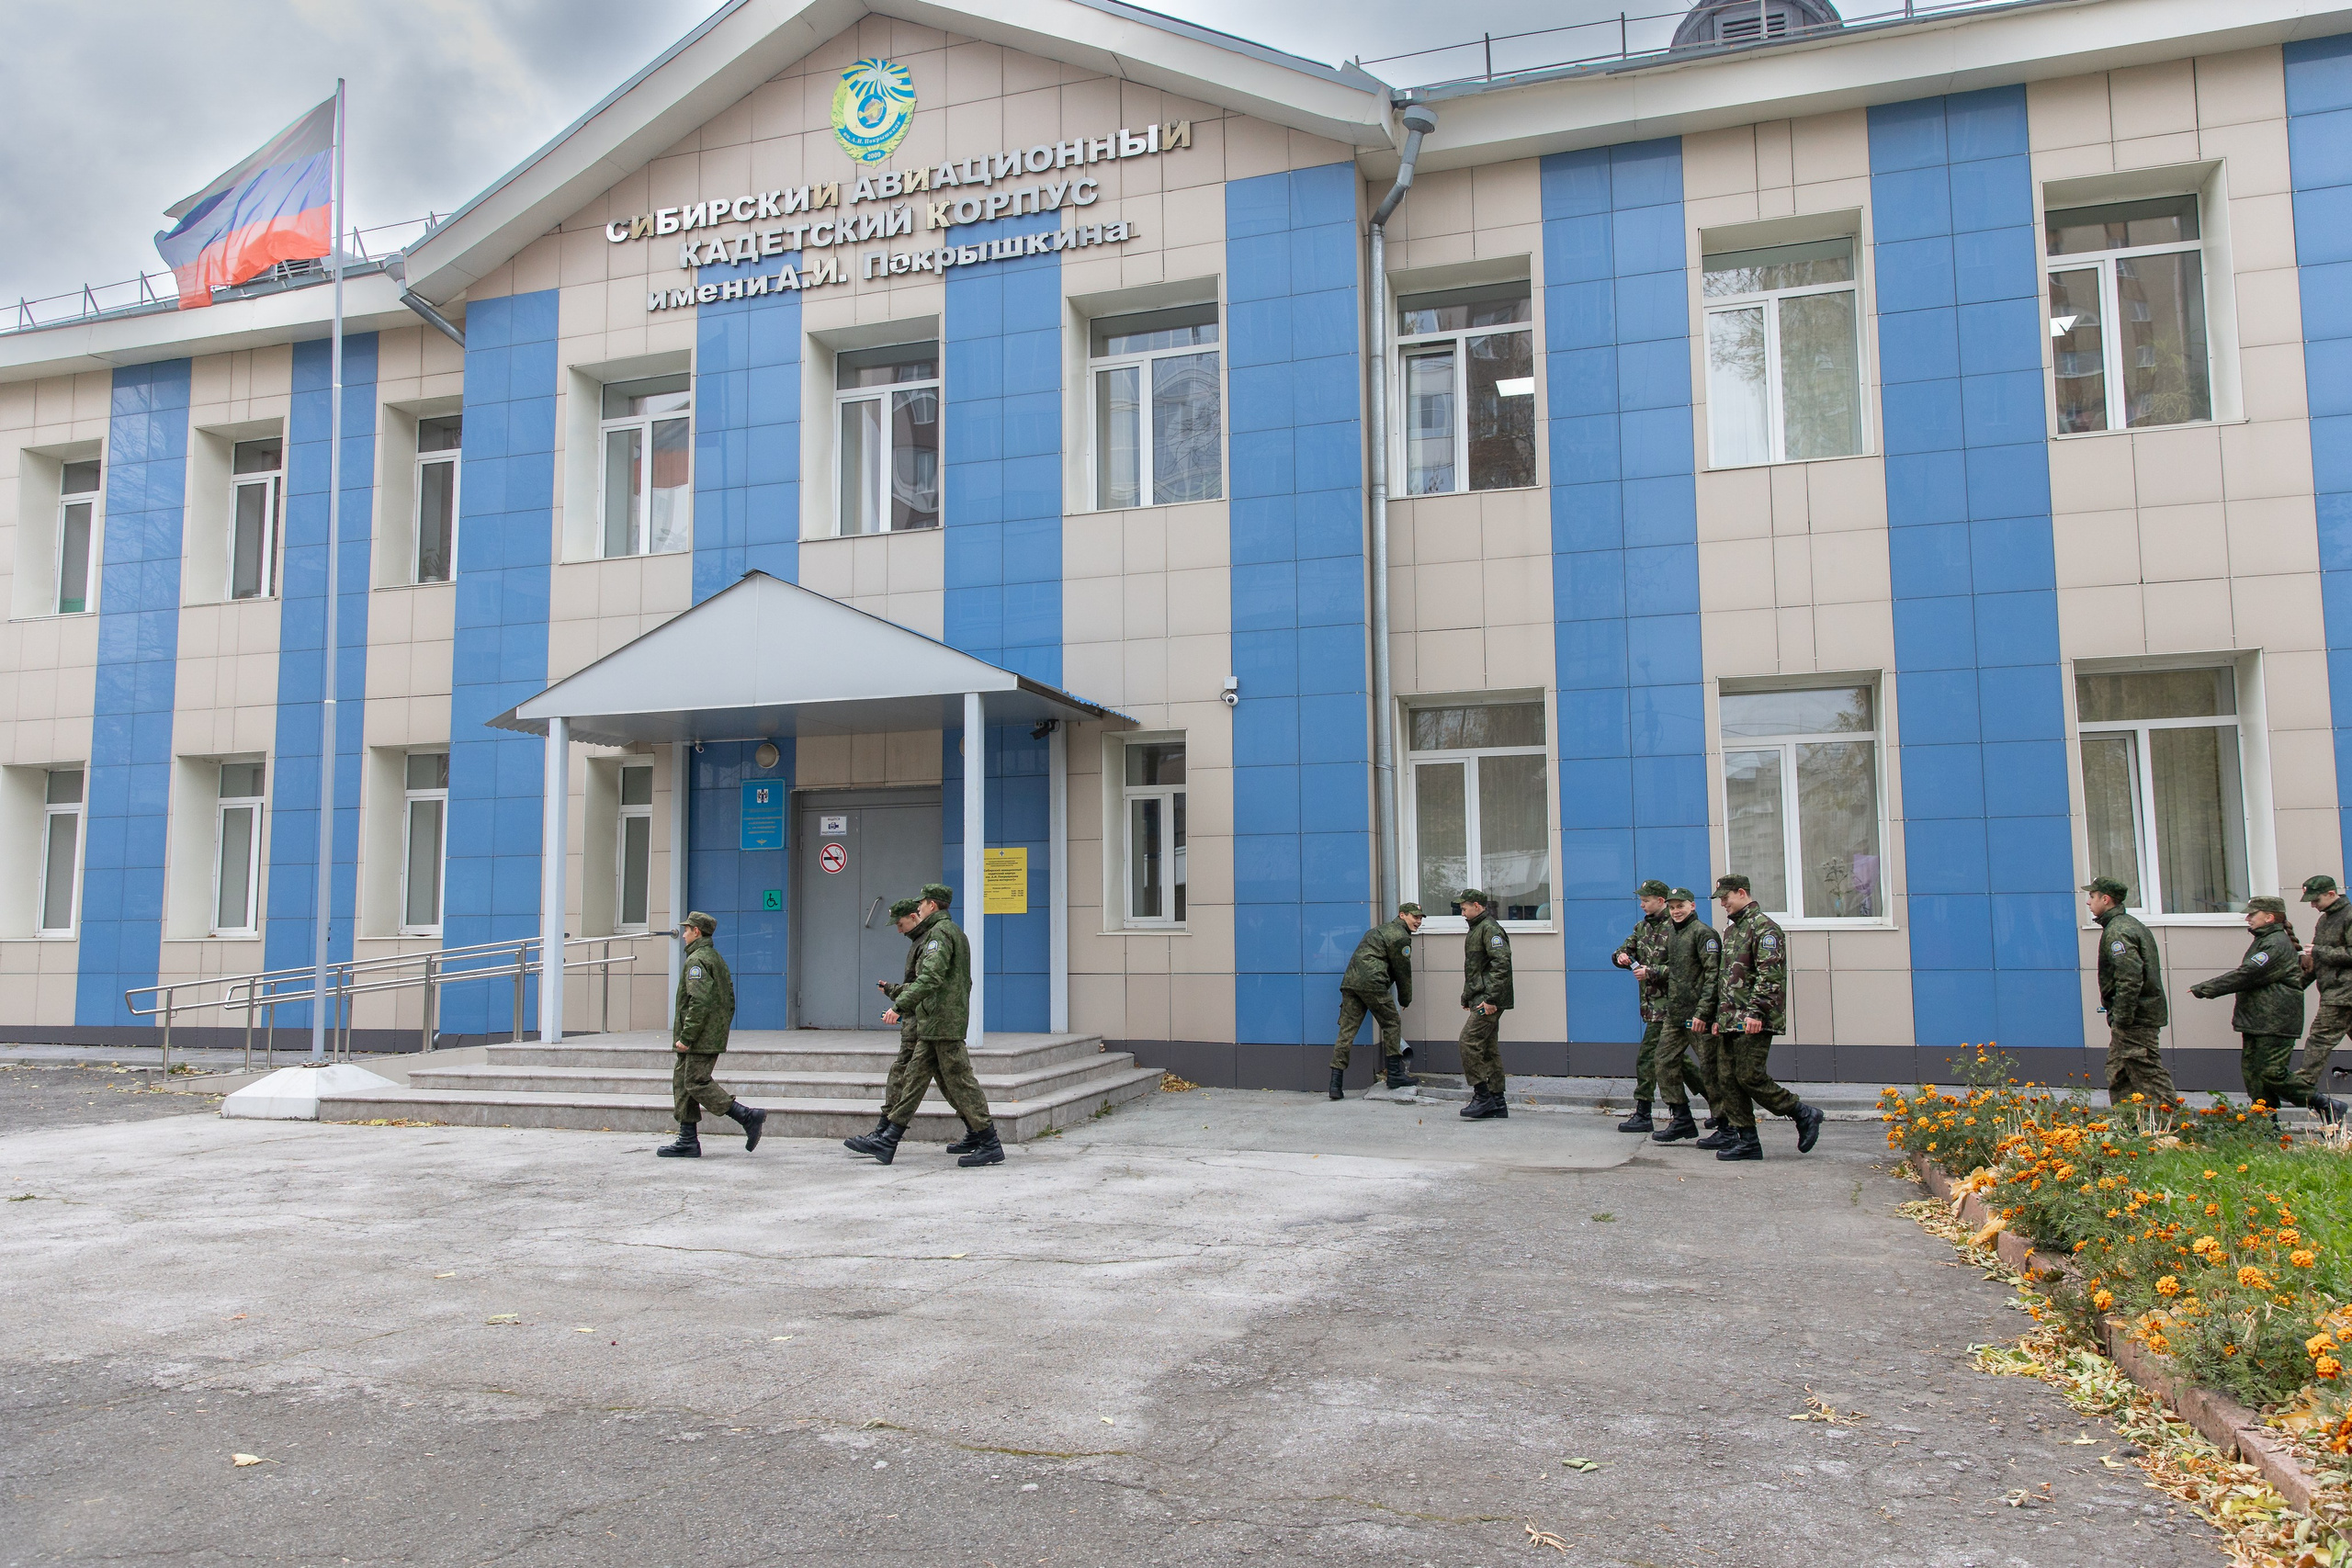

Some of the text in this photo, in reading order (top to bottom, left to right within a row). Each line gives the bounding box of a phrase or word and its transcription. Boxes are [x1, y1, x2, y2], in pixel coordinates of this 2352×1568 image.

[867, 152, 881, 160] 2009
[647, 275, 769, 312] имени
[864, 220, 1130, 280] Покрышкина
[679, 177, 1099, 269] КАДЕТСКИЙ КОРПУС
